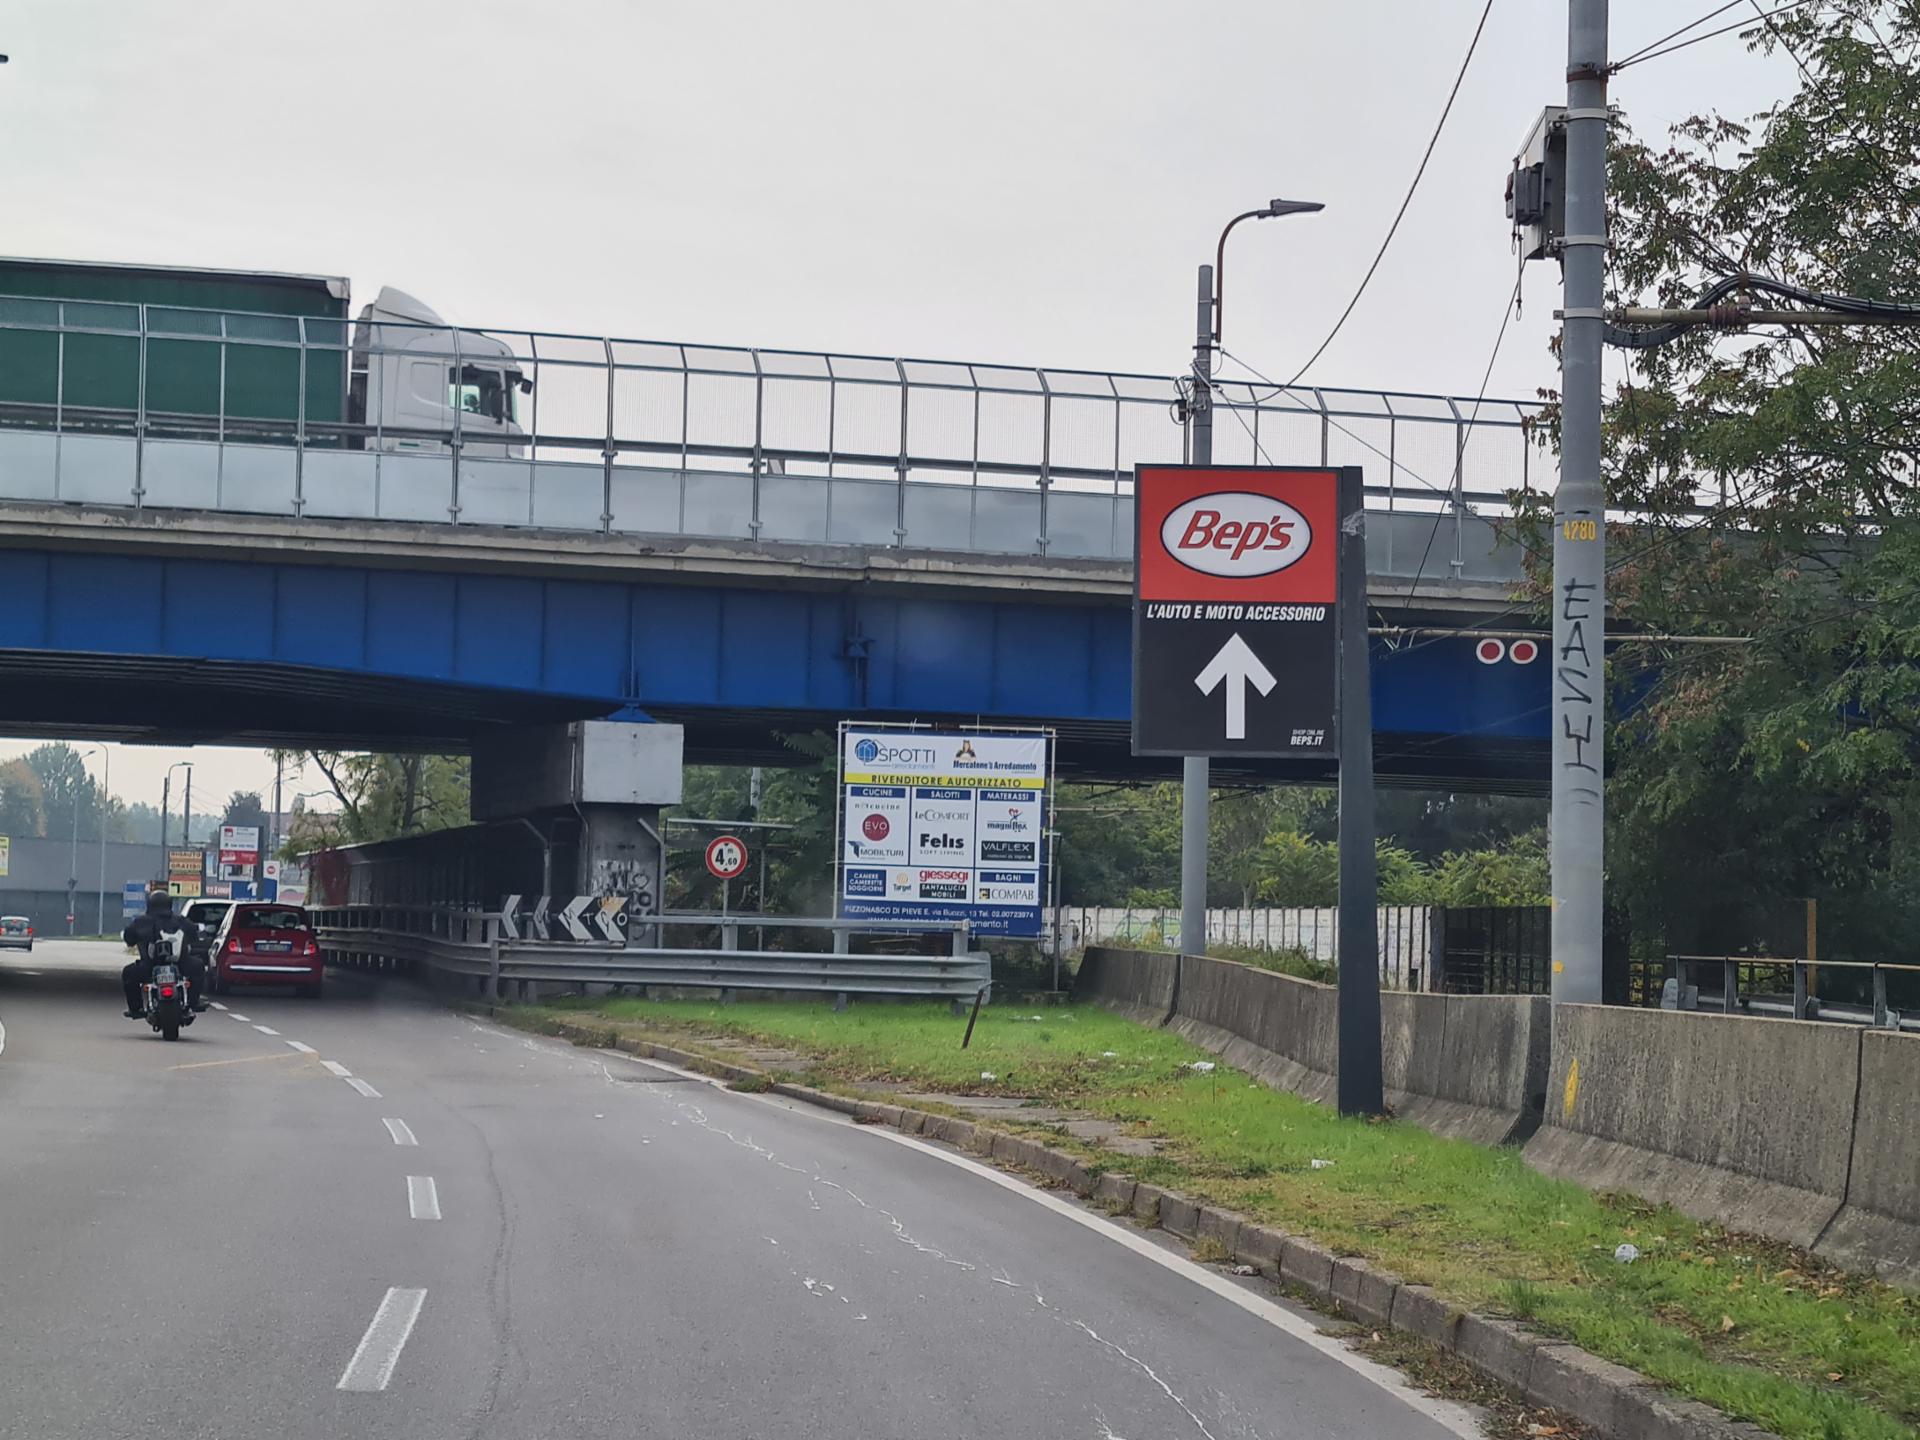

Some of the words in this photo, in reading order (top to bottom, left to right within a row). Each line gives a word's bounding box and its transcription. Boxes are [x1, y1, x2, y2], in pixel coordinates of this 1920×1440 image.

[1178, 510, 1295, 560] Bep's
[1146, 604, 1191, 619] L'AUTO
[1193, 605, 1203, 619] E
[1205, 605, 1243, 620] MOTO
[1245, 606, 1326, 622] ACCESSORIO
[1290, 735, 1324, 746] BEPS.IT
[878, 748, 936, 763] SPOTTI
[871, 775, 943, 786] RIVENDITORE
[947, 777, 1022, 789] AUTORIZZATO
[862, 788, 893, 796] CUCINE
[930, 790, 960, 799] SALOTTI
[986, 792, 1029, 801] MATERASSI
[864, 820, 888, 831] EVO
[920, 833, 965, 849] Felis
[860, 849, 904, 857] MOBILTURI
[982, 843, 1030, 852] VALFLEX
[919, 870, 969, 883] giessegi
[995, 874, 1021, 882] BAGNI
[893, 884, 912, 892] Target
[991, 888, 1034, 900] COMPAB
[901, 907, 923, 916] PIEVE
